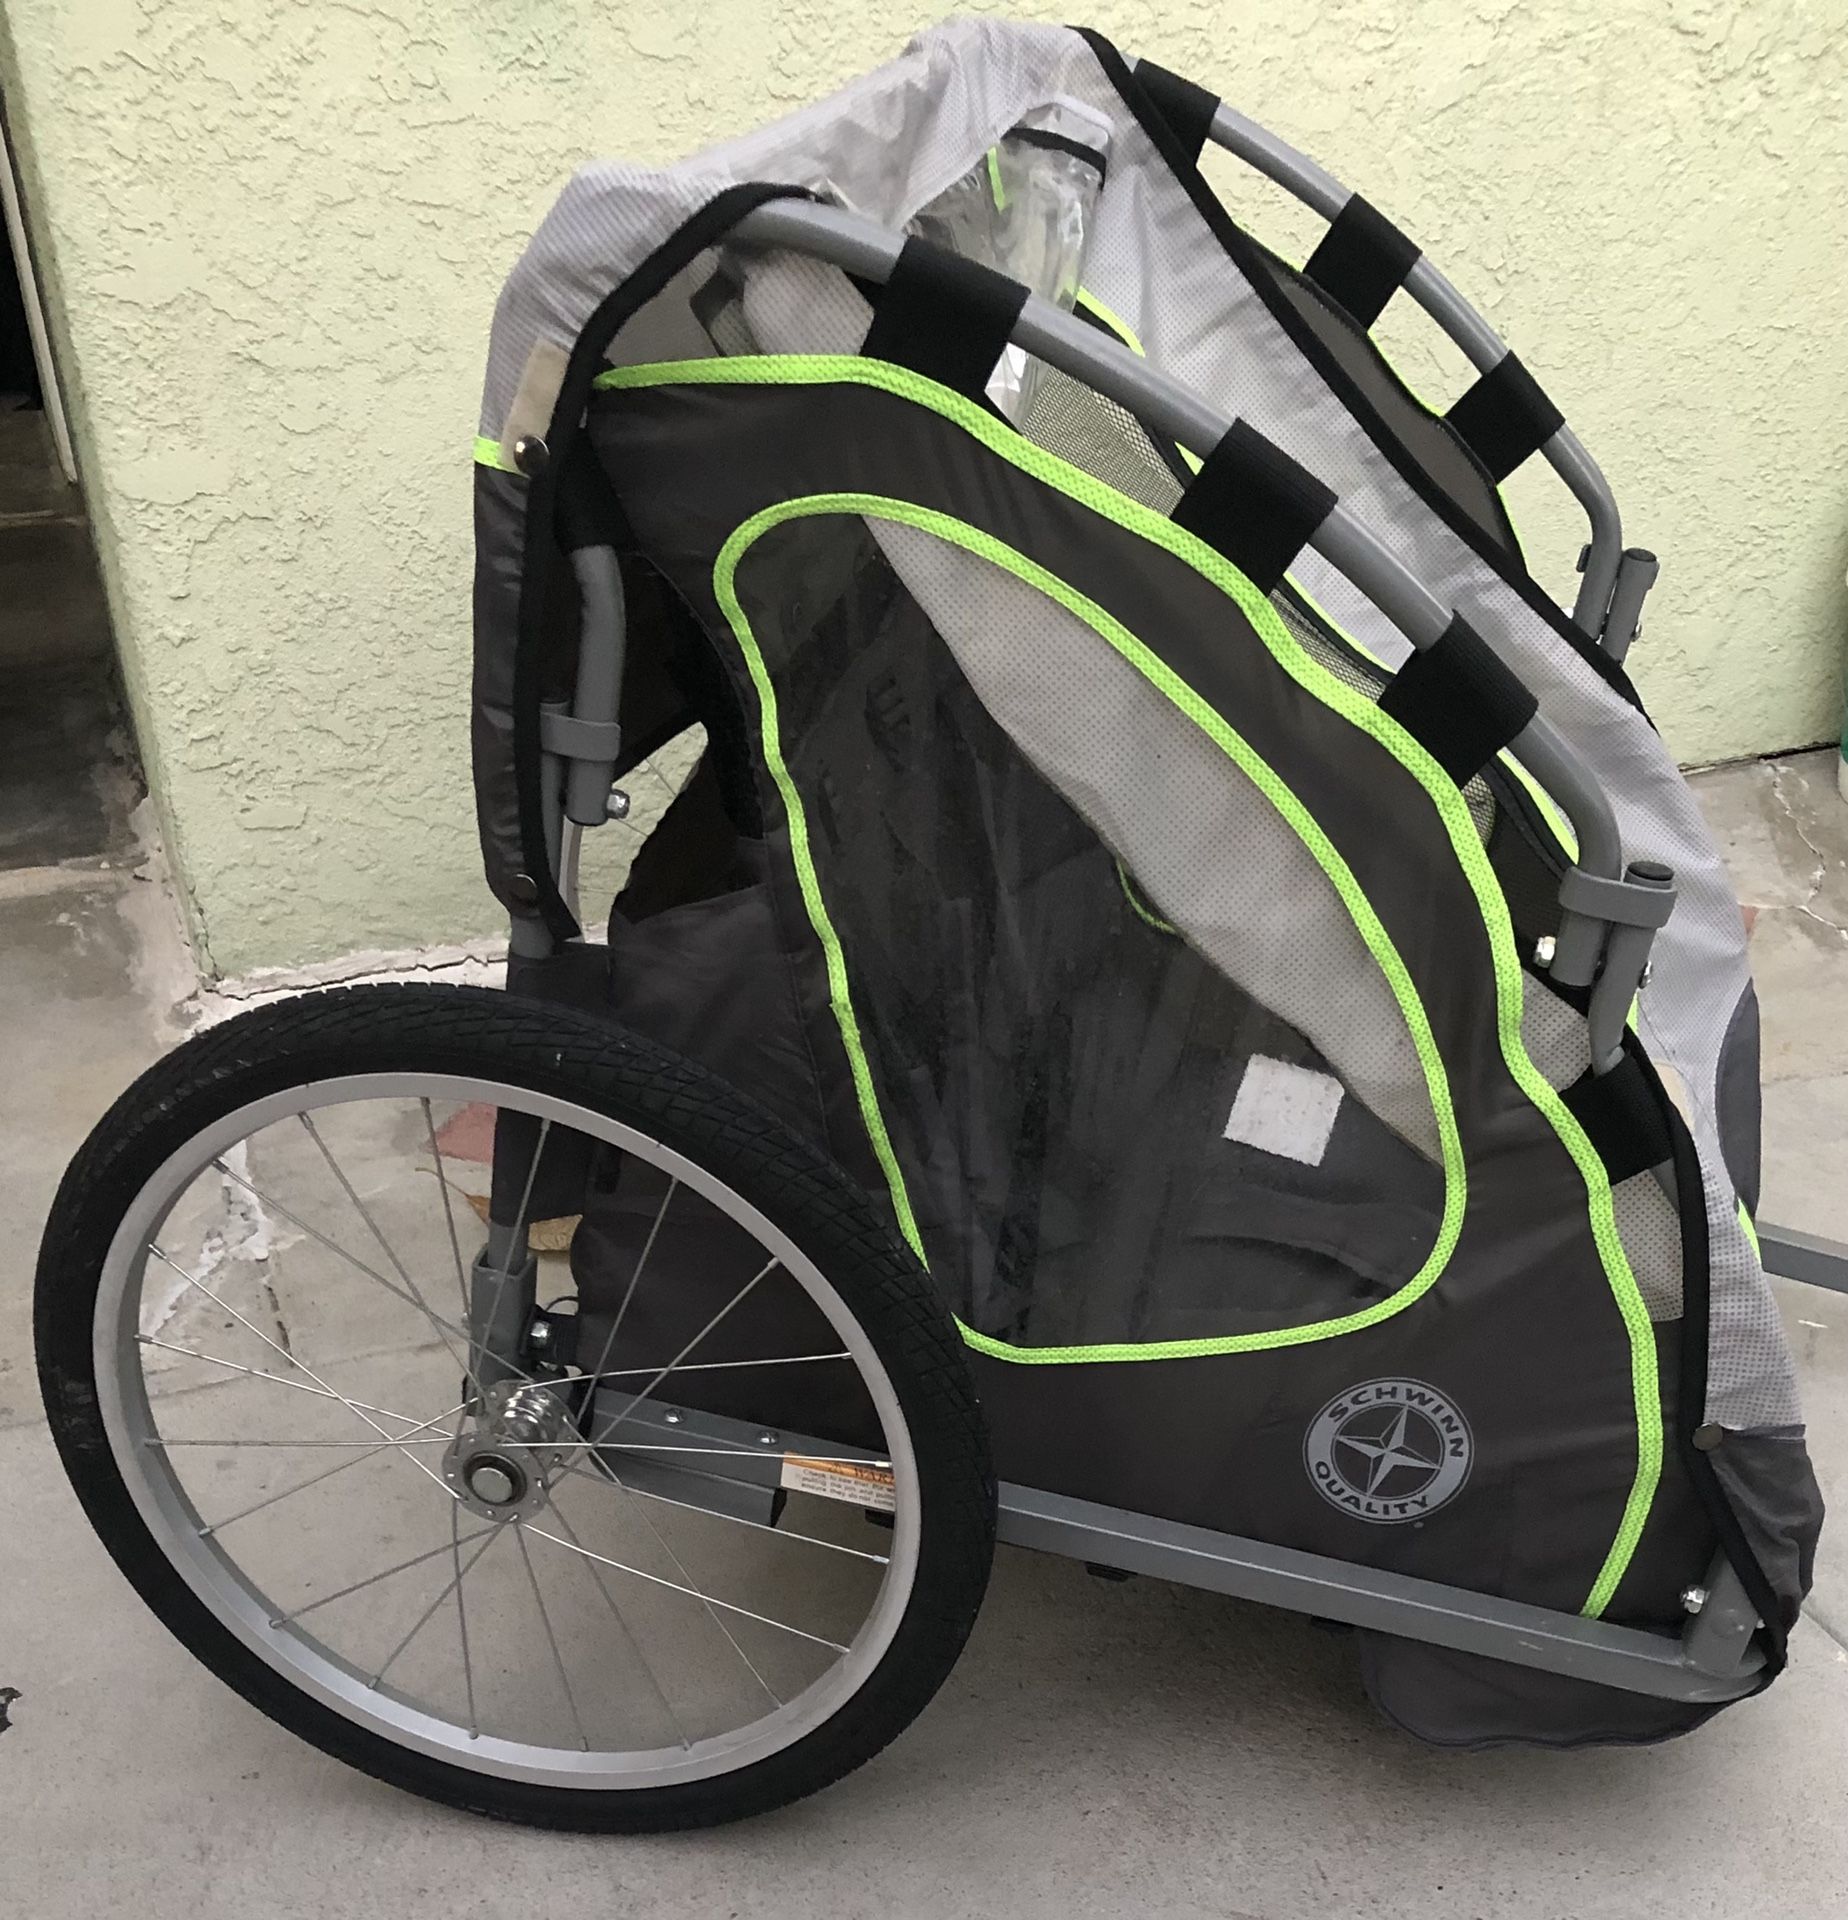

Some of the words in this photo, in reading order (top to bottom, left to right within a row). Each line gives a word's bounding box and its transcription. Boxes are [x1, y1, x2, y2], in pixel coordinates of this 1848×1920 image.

[1327, 1386, 1465, 1458] SCHWINN
[803, 1468, 826, 1479] Check
[1314, 1460, 1429, 1516] QUALITY
